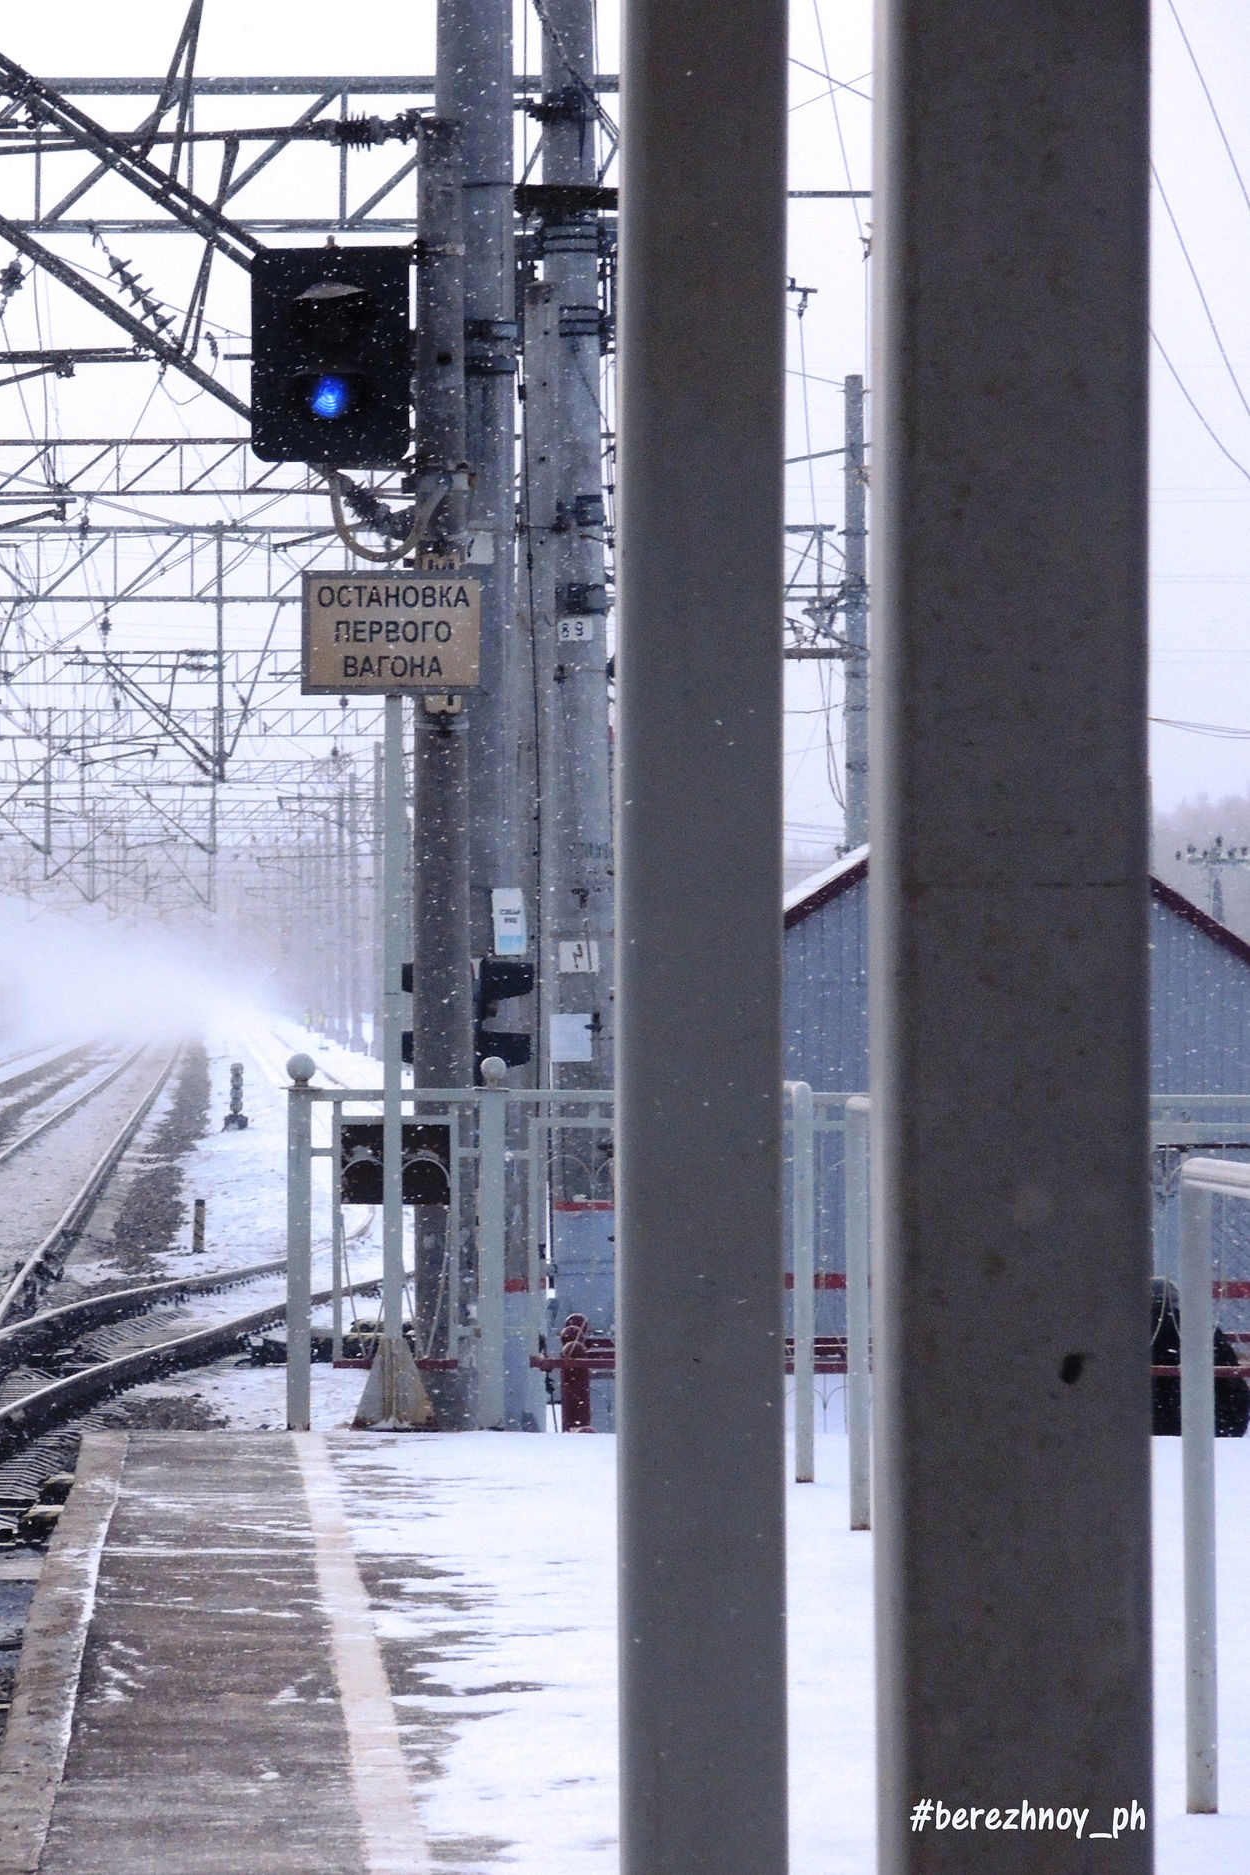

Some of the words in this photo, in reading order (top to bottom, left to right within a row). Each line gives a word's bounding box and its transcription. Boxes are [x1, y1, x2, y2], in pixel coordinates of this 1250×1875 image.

[317, 585, 470, 608] ОСТАНОВКА
[334, 620, 452, 643] ПЕРВОГО
[343, 655, 443, 678] ВАГОНА
